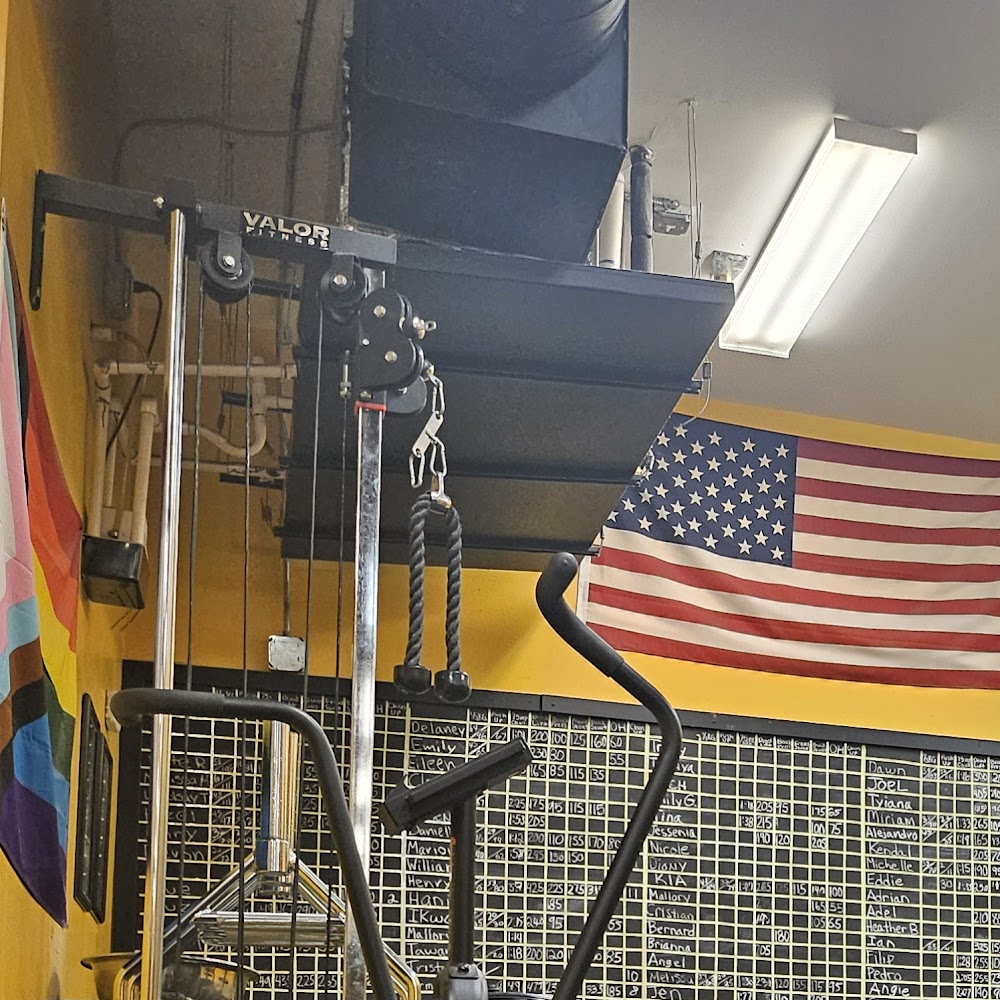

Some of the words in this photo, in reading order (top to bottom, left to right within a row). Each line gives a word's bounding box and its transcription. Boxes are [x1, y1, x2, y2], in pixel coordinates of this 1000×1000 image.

[243, 211, 330, 241] VALOR
[246, 226, 329, 249] FITNESS
[411, 720, 466, 738] Delaney
[610, 723, 626, 733] OH
[411, 739, 456, 755] Emily
[829, 744, 844, 755] OH
[409, 757, 456, 772] Eileen
[869, 761, 907, 776] Dawn
[663, 794, 682, 808] ily
[868, 794, 912, 811] Tyiana
[868, 810, 915, 826] Miriam
[408, 822, 451, 838] Daniell
[648, 825, 697, 839] Jessenia
[866, 828, 918, 841] Alejandro
[407, 841, 451, 856] Mario
[650, 841, 690, 856] Nicole
[868, 842, 912, 857] Kendal
[866, 858, 913, 872] Michelle
[654, 874, 687, 887] KIA
[867, 873, 904, 887] Eddie
[648, 889, 691, 903] Mallory
[867, 889, 910, 904] Adrian
[867, 905, 897, 918] Adel
[648, 921, 695, 936] Bernard
[866, 919, 907, 935] Heather
[909, 922, 919, 936] B
[647, 938, 691, 953] Brianna
[867, 936, 896, 948] Ian
[408, 962, 444, 974] Trist
[648, 953, 686, 968] Angel
[650, 972, 694, 985] Melissa
[867, 968, 902, 981] Pedro
[650, 985, 682, 1000] Jen
[869, 982, 910, 998] Angie
